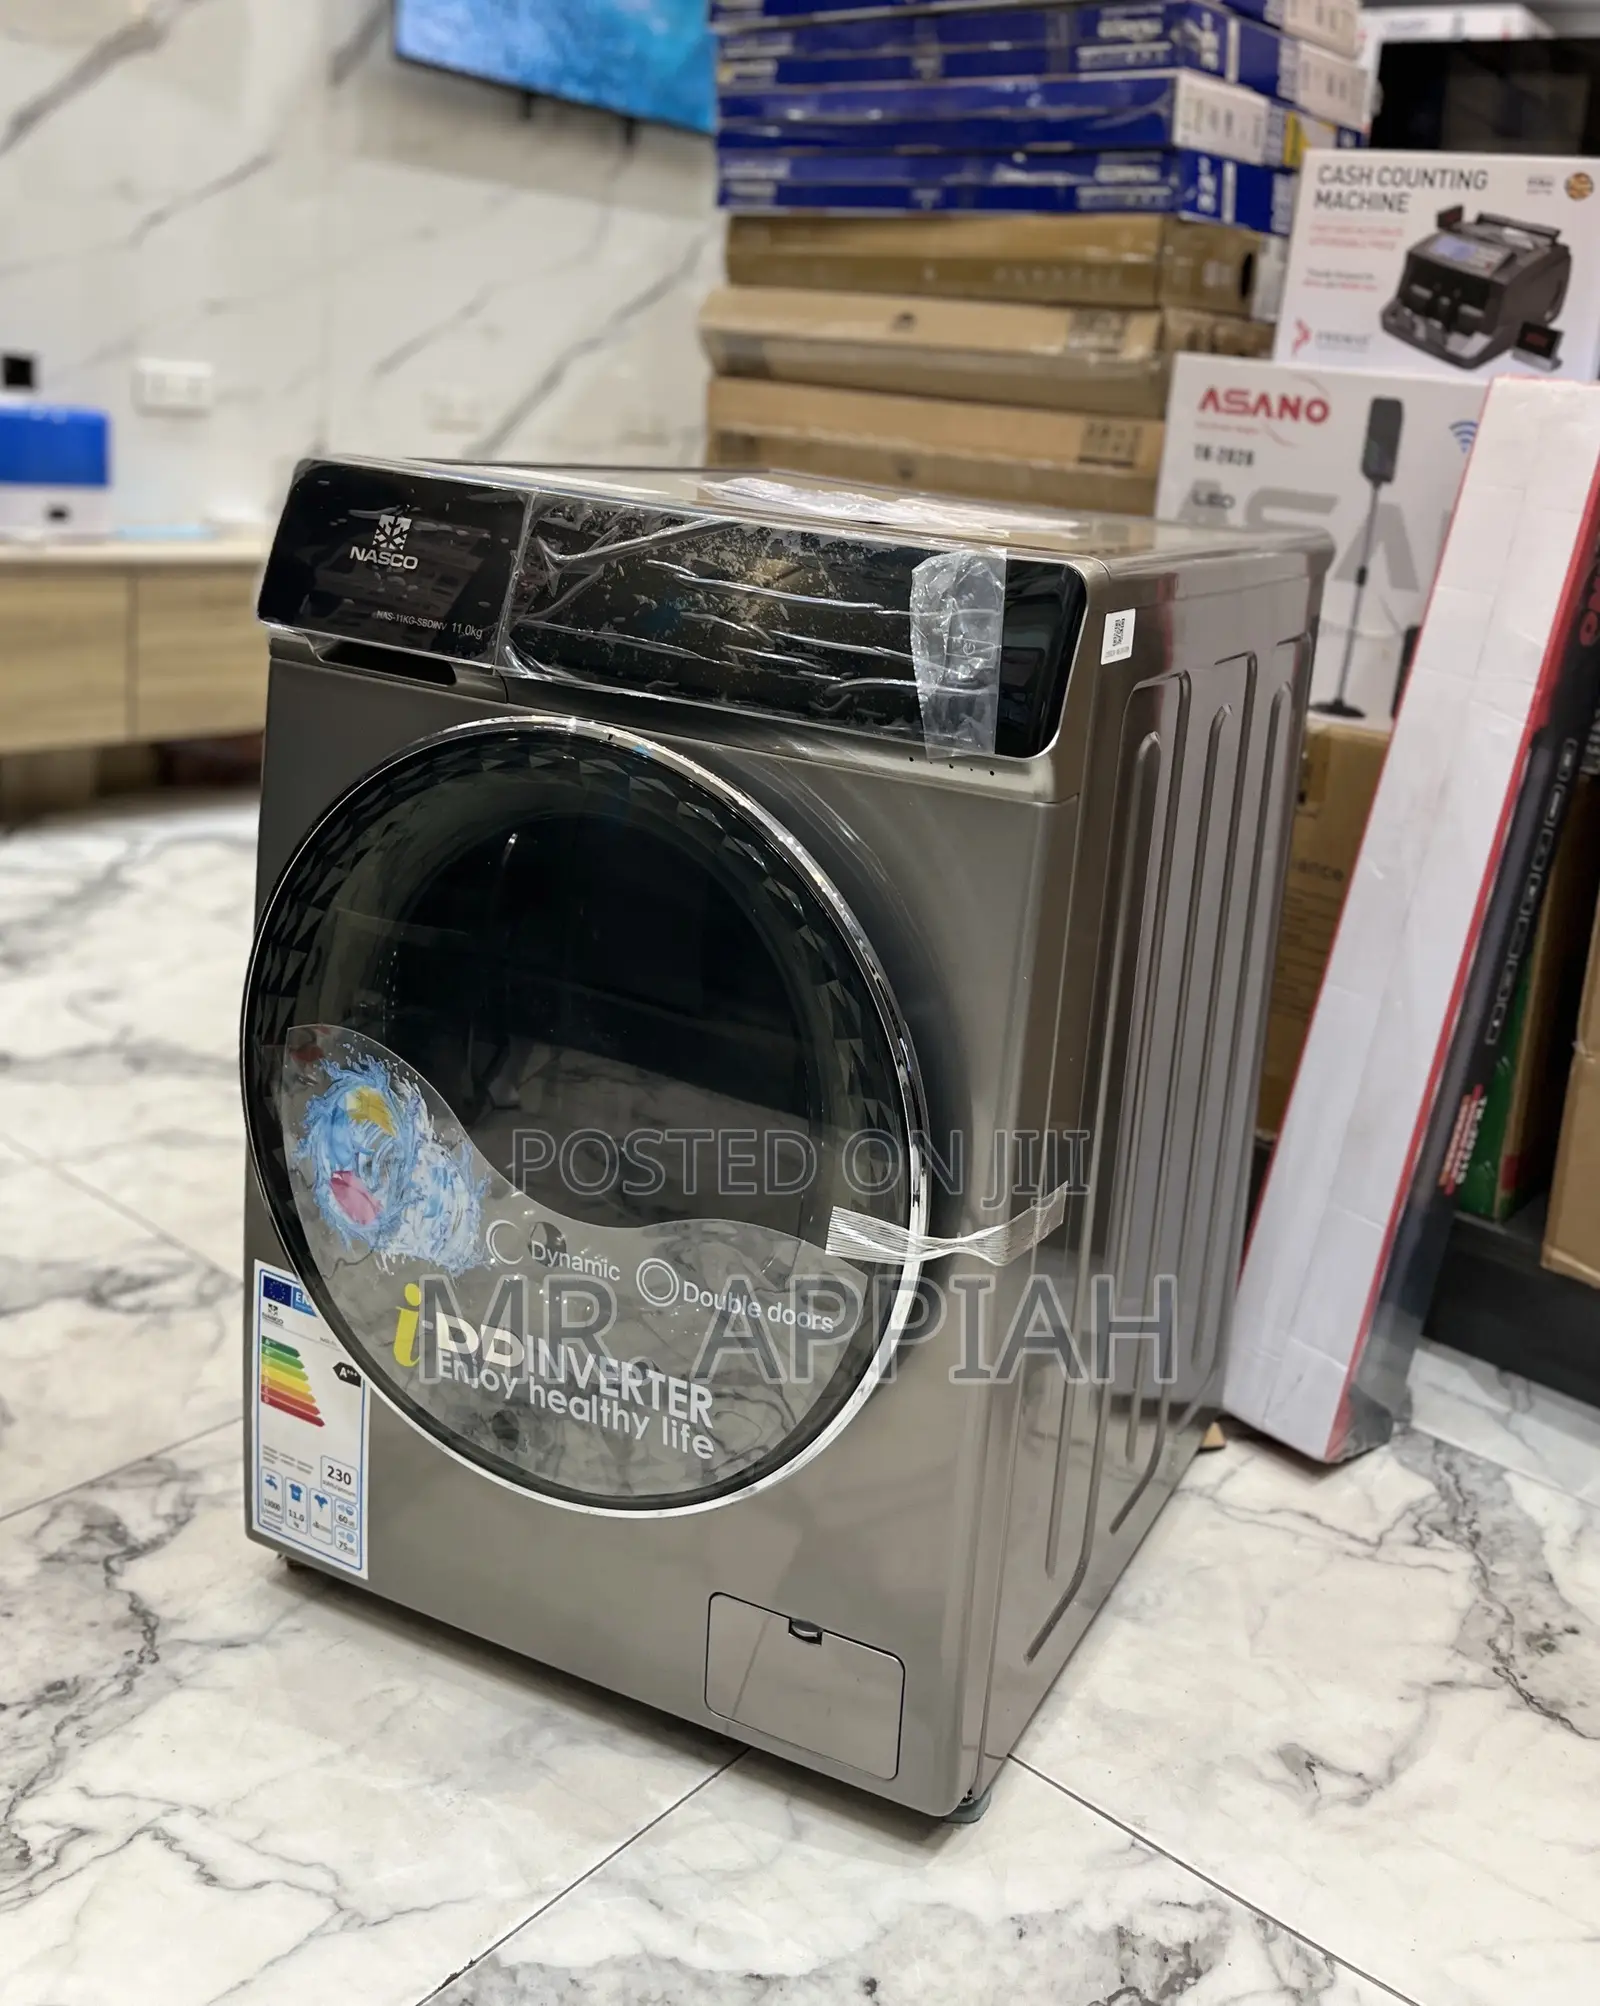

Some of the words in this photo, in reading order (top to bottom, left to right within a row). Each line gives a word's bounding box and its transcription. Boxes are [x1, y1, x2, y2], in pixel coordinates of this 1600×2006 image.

[1317, 165, 1372, 187] CASH
[1377, 167, 1488, 190] COUNTING
[1313, 190, 1411, 214] MACHINE
[1198, 387, 1331, 424] ASANO
[349, 546, 419, 570] NASCO
[452, 622, 483, 640] 11.0kg
[530, 1240, 621, 1282] Dynamic
[683, 1280, 761, 1318] Double
[768, 1300, 835, 1334] doors
[438, 1350, 518, 1400] Enjoy
[529, 1375, 650, 1440] healthy
[662, 1416, 715, 1460] life
[327, 1465, 352, 1486] 230
[288, 1509, 305, 1522] 11.0
[338, 1514, 348, 1524] 60
[339, 1540, 348, 1551] 75
